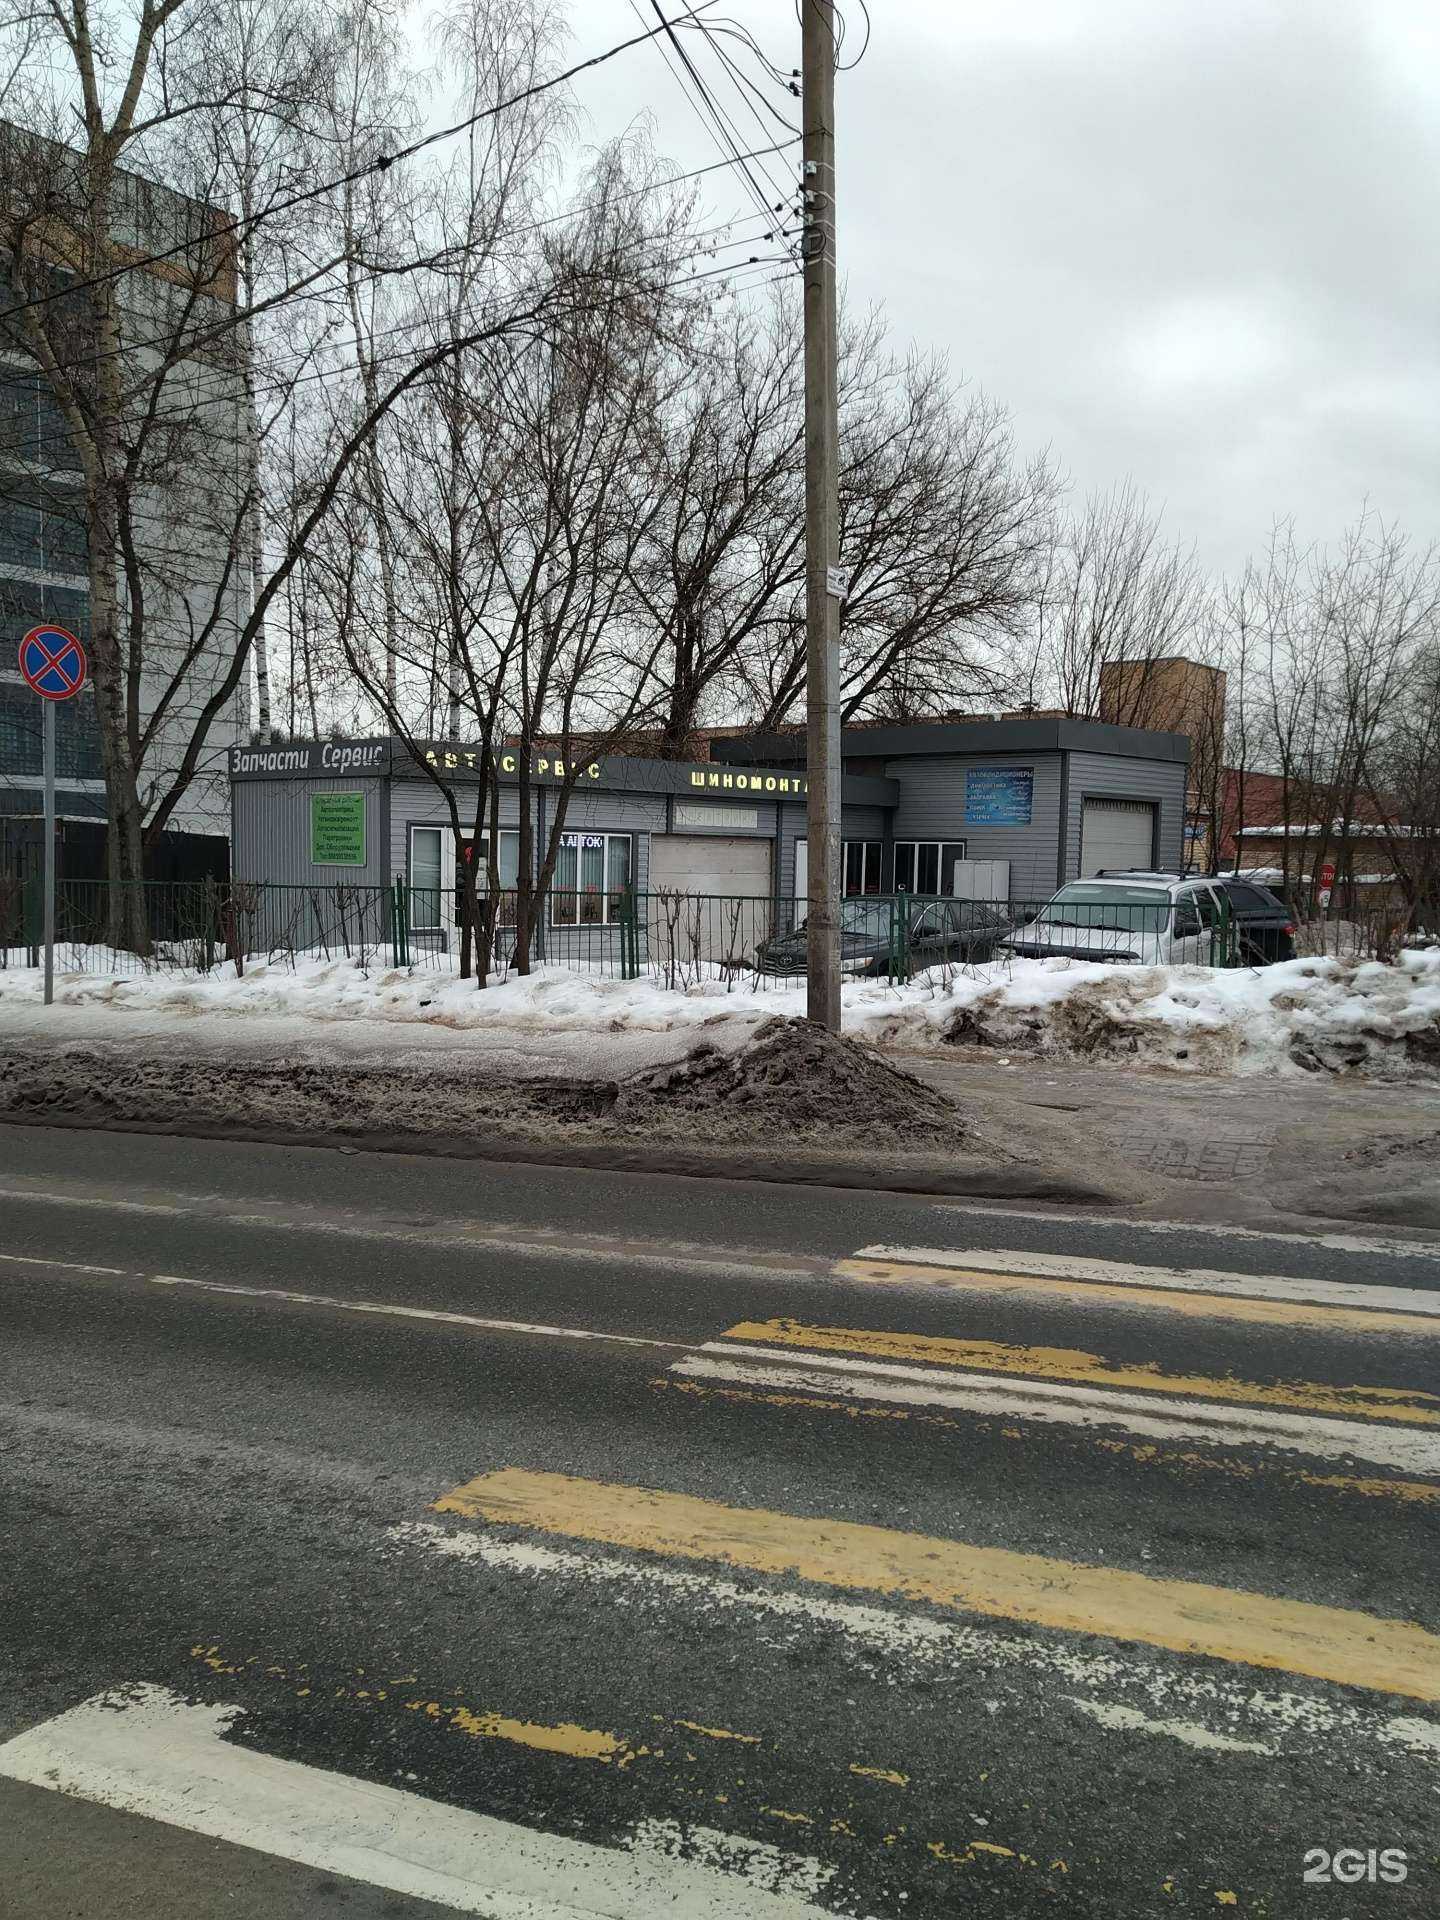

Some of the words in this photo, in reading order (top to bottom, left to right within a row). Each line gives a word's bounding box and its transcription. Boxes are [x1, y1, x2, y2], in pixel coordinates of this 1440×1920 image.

[232, 749, 310, 773] Запчасти
[321, 743, 383, 773] Сервис
[425, 750, 600, 779] АВТСРВС
[691, 772, 808, 793] ШИНОМОНТ
